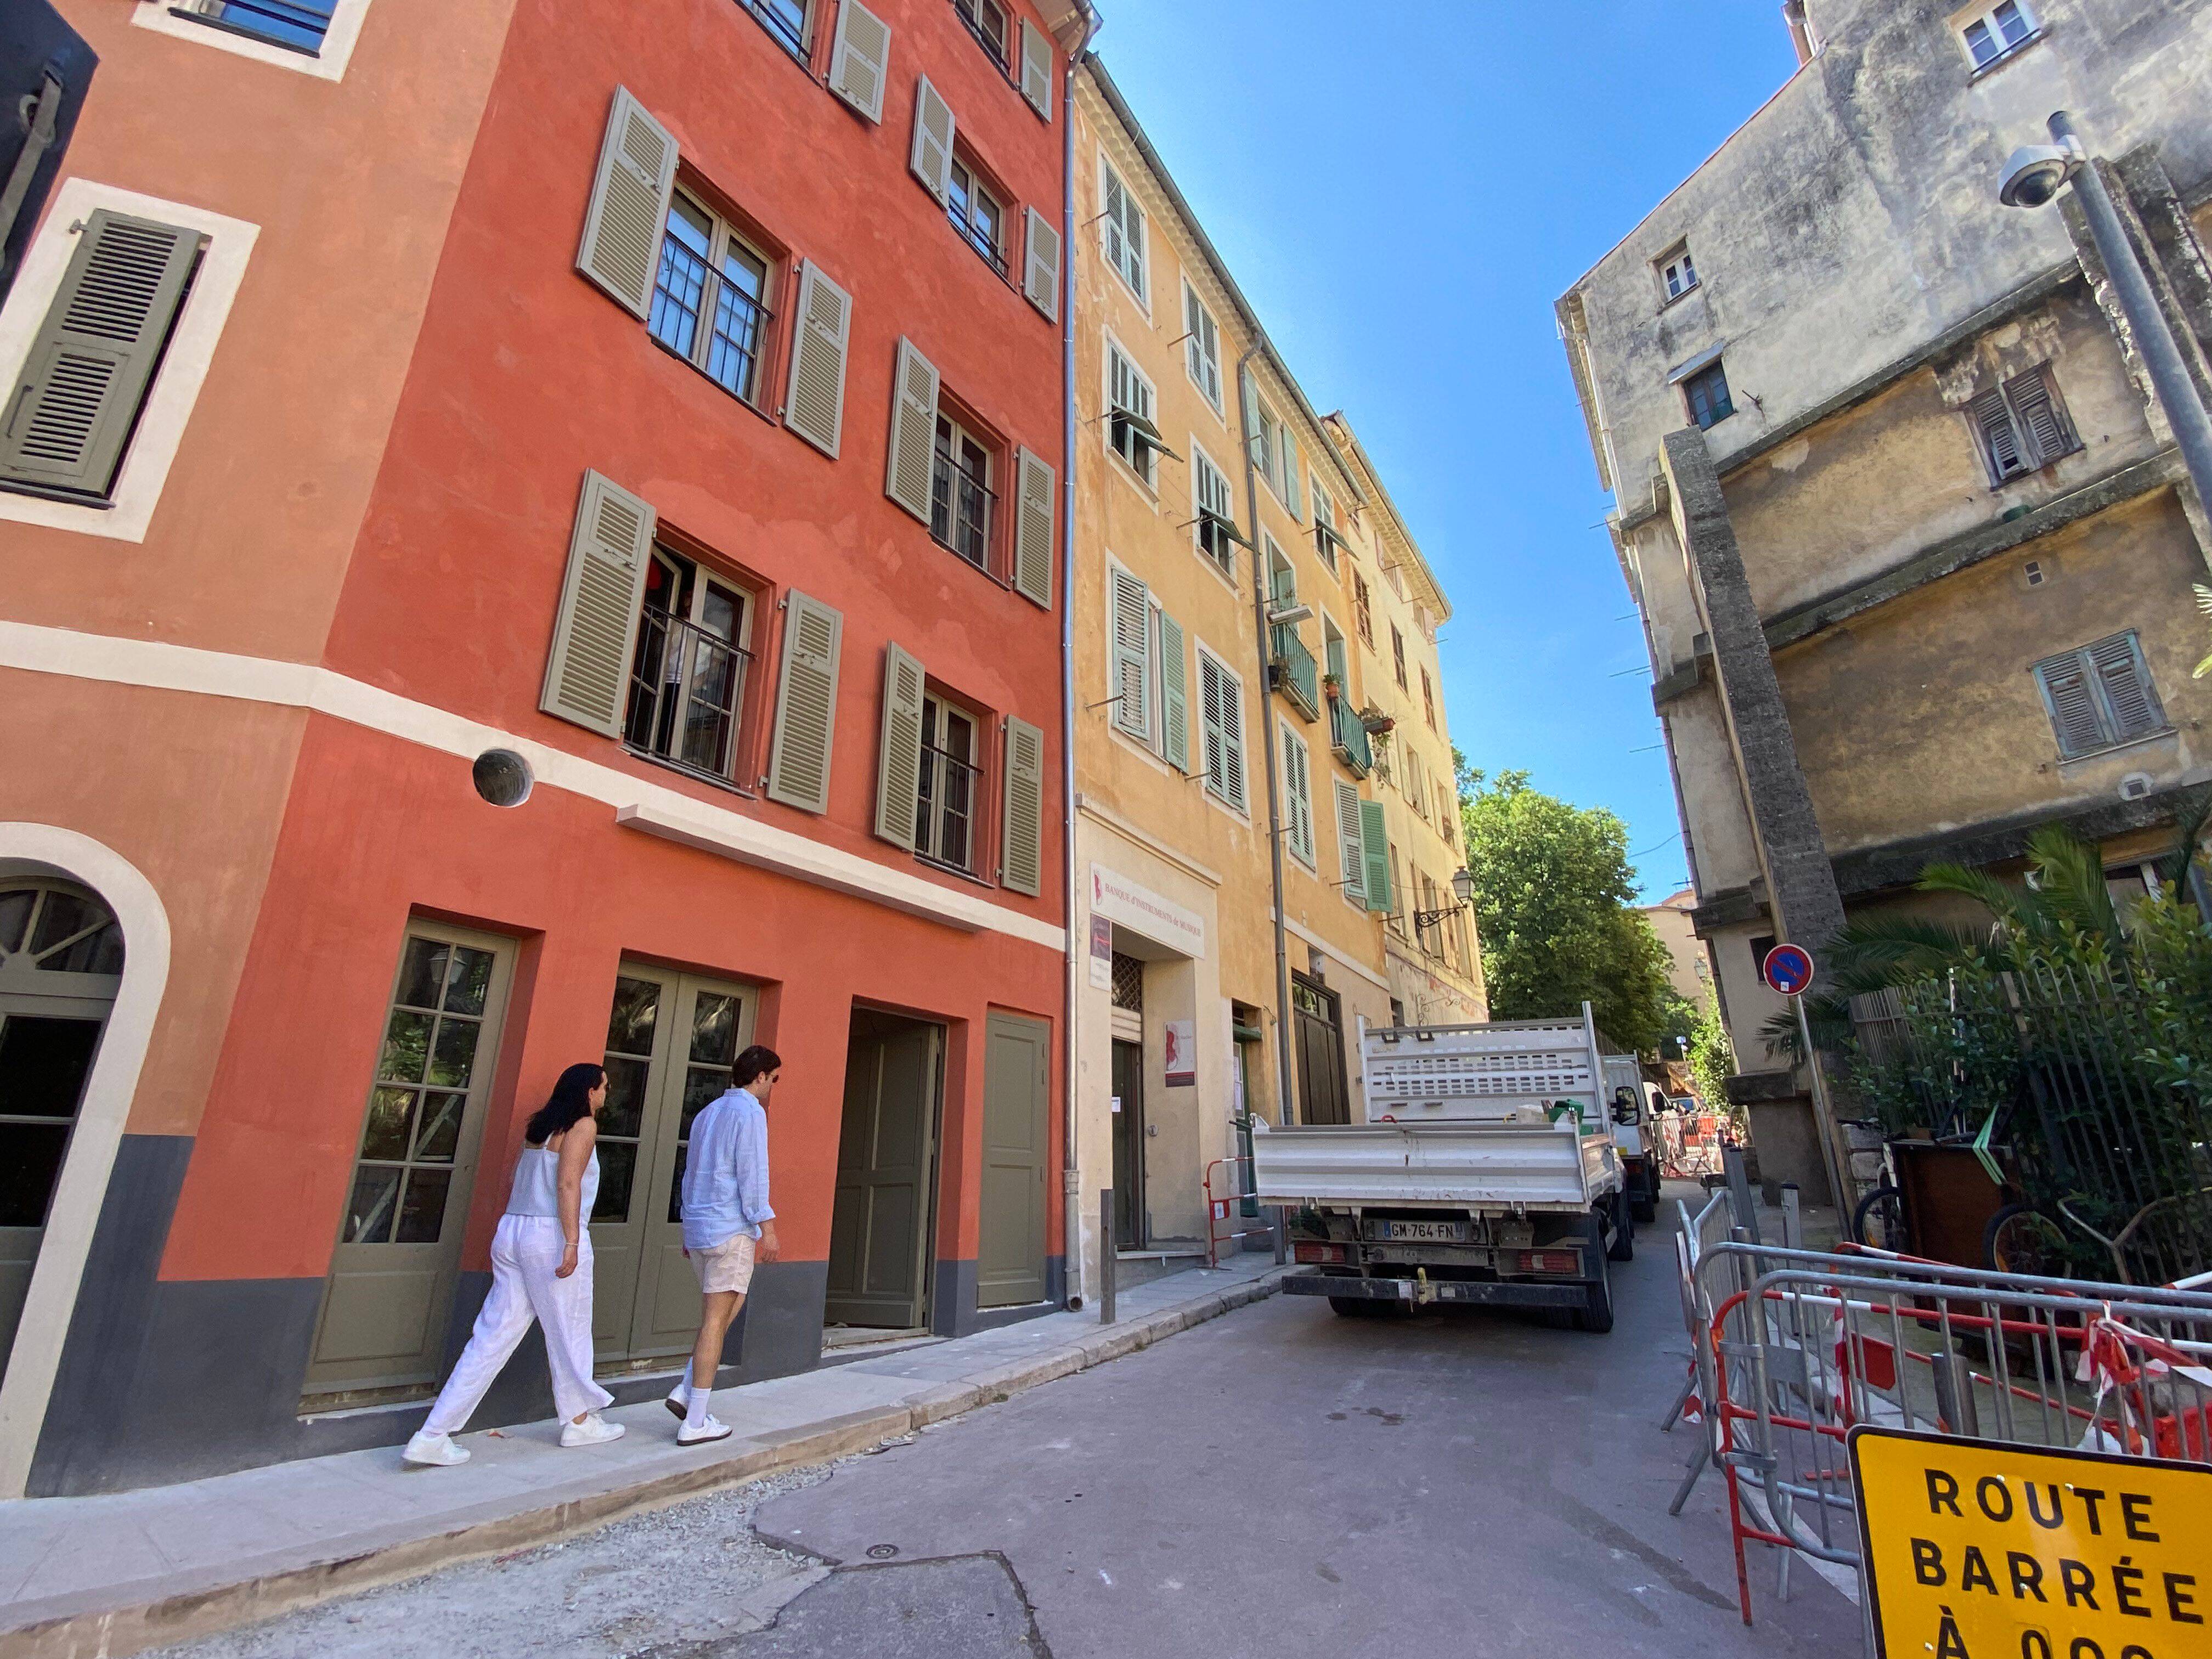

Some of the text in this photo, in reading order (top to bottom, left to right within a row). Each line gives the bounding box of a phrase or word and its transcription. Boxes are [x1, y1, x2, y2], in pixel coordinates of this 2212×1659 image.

[1105, 883, 1130, 902] BANQUE
[1924, 1468, 2160, 1543] ROUTE
[1910, 1537, 2204, 1625] BARRÉE
